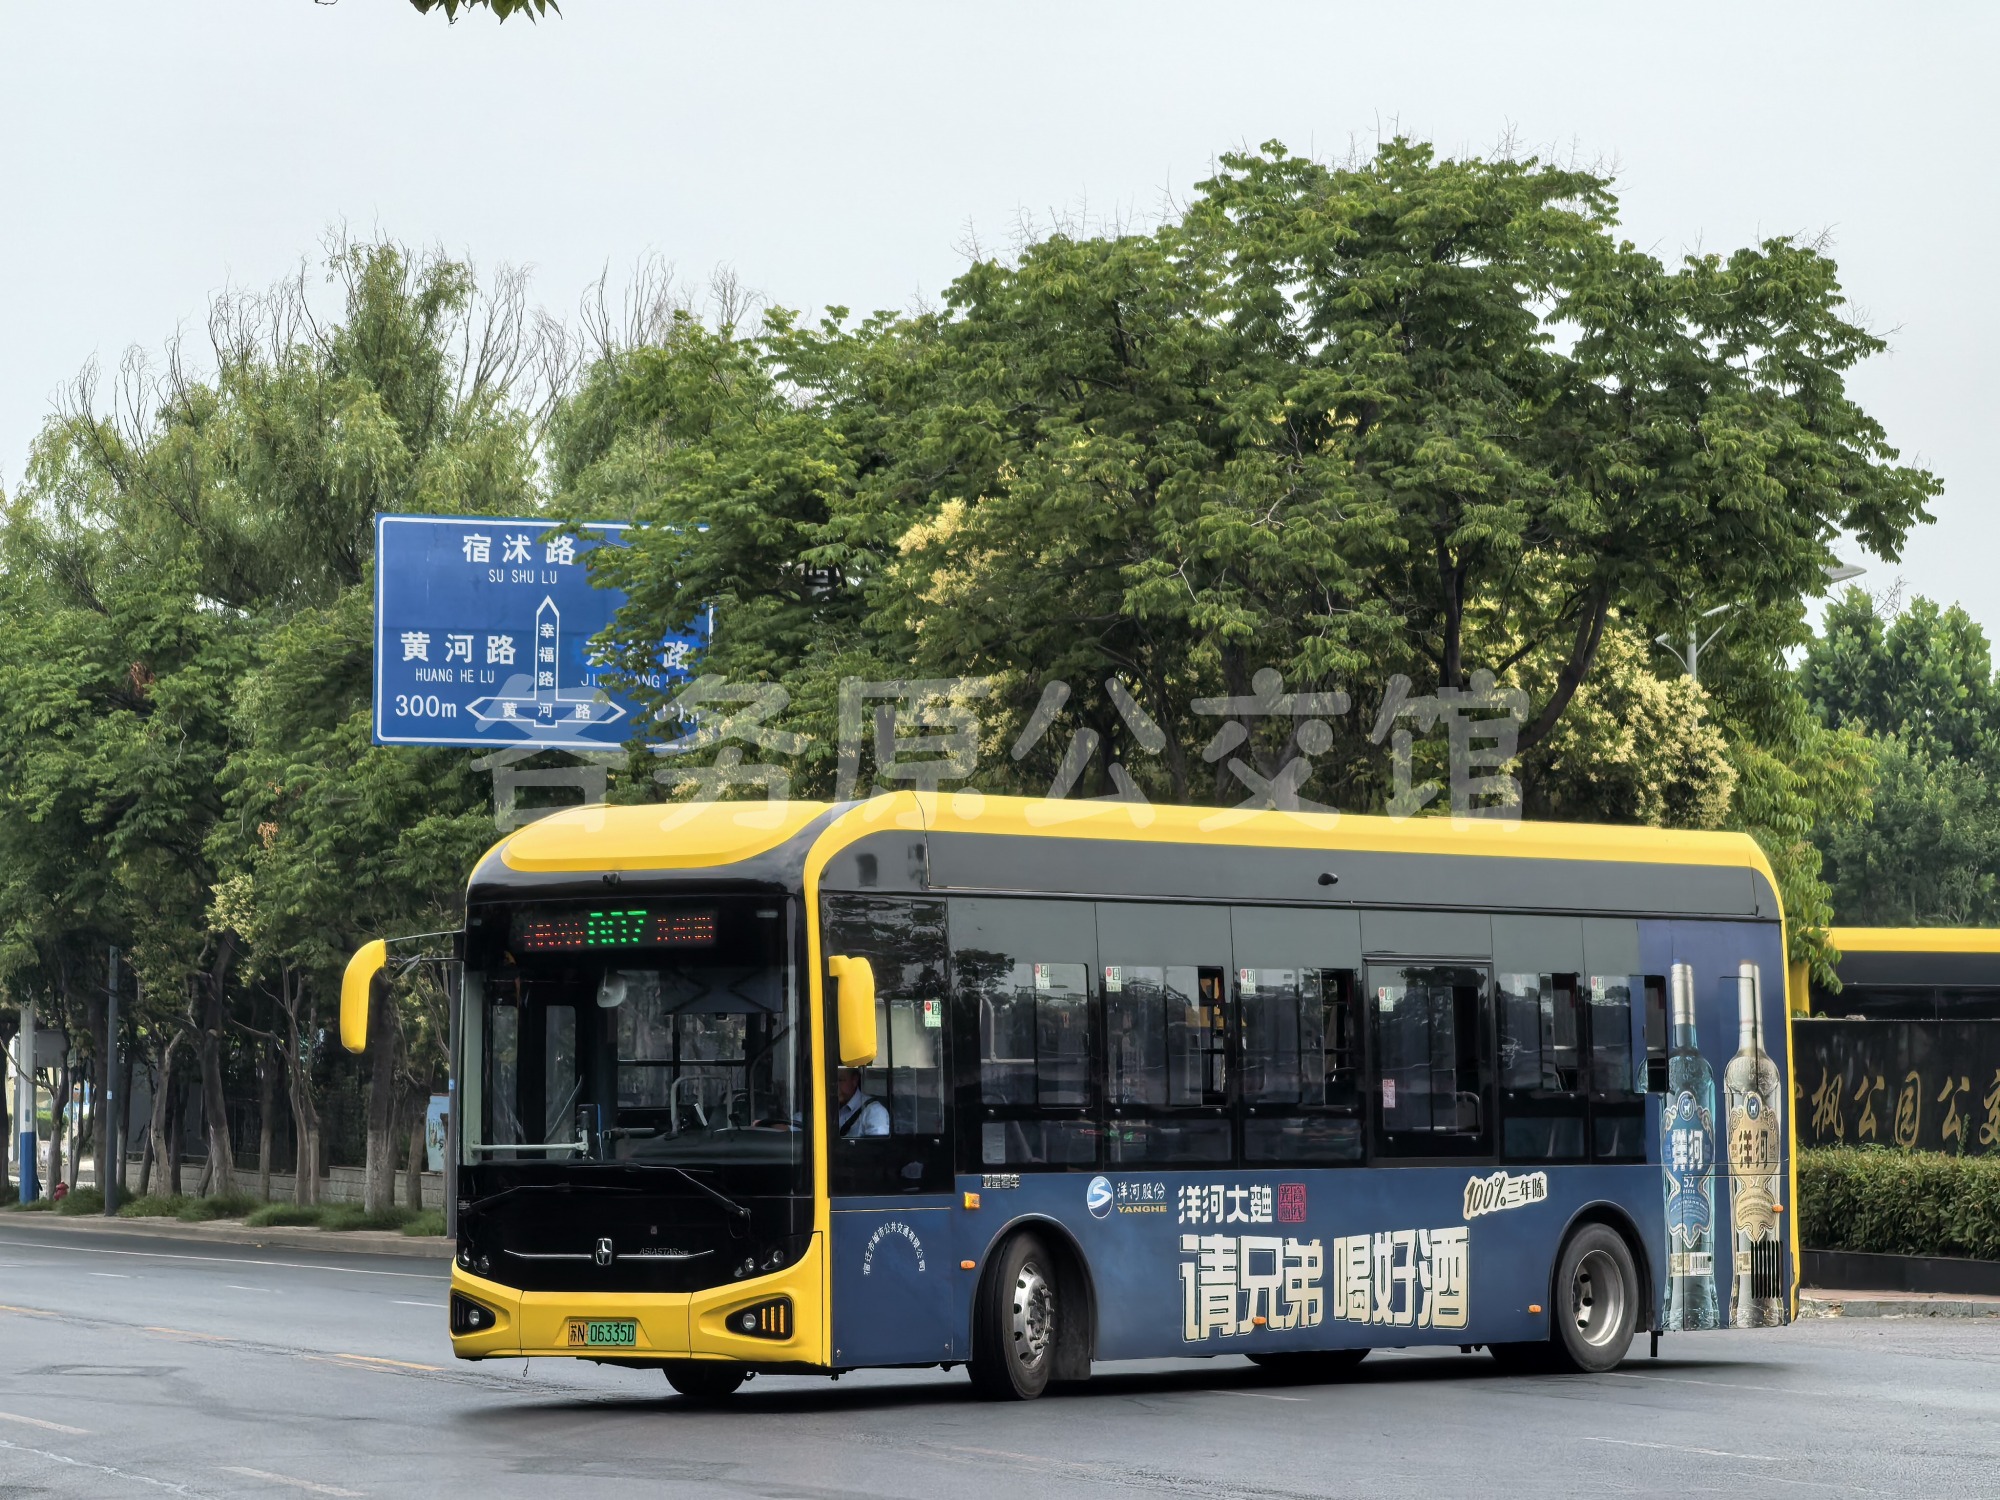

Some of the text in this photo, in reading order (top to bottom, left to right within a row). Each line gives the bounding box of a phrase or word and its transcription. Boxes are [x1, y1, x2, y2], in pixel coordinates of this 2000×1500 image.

[488, 569, 558, 585] SU SHU LU
[401, 631, 517, 665] 黄河路
[539, 622, 555, 688] 幸福路
[415, 668, 495, 684] HUANG HE LU
[395, 695, 457, 719] 300m
[502, 702, 591, 719] 黄河路
[1116, 1181, 1166, 1201] 洋河股份
[1116, 1205, 1168, 1214] YANGHE
